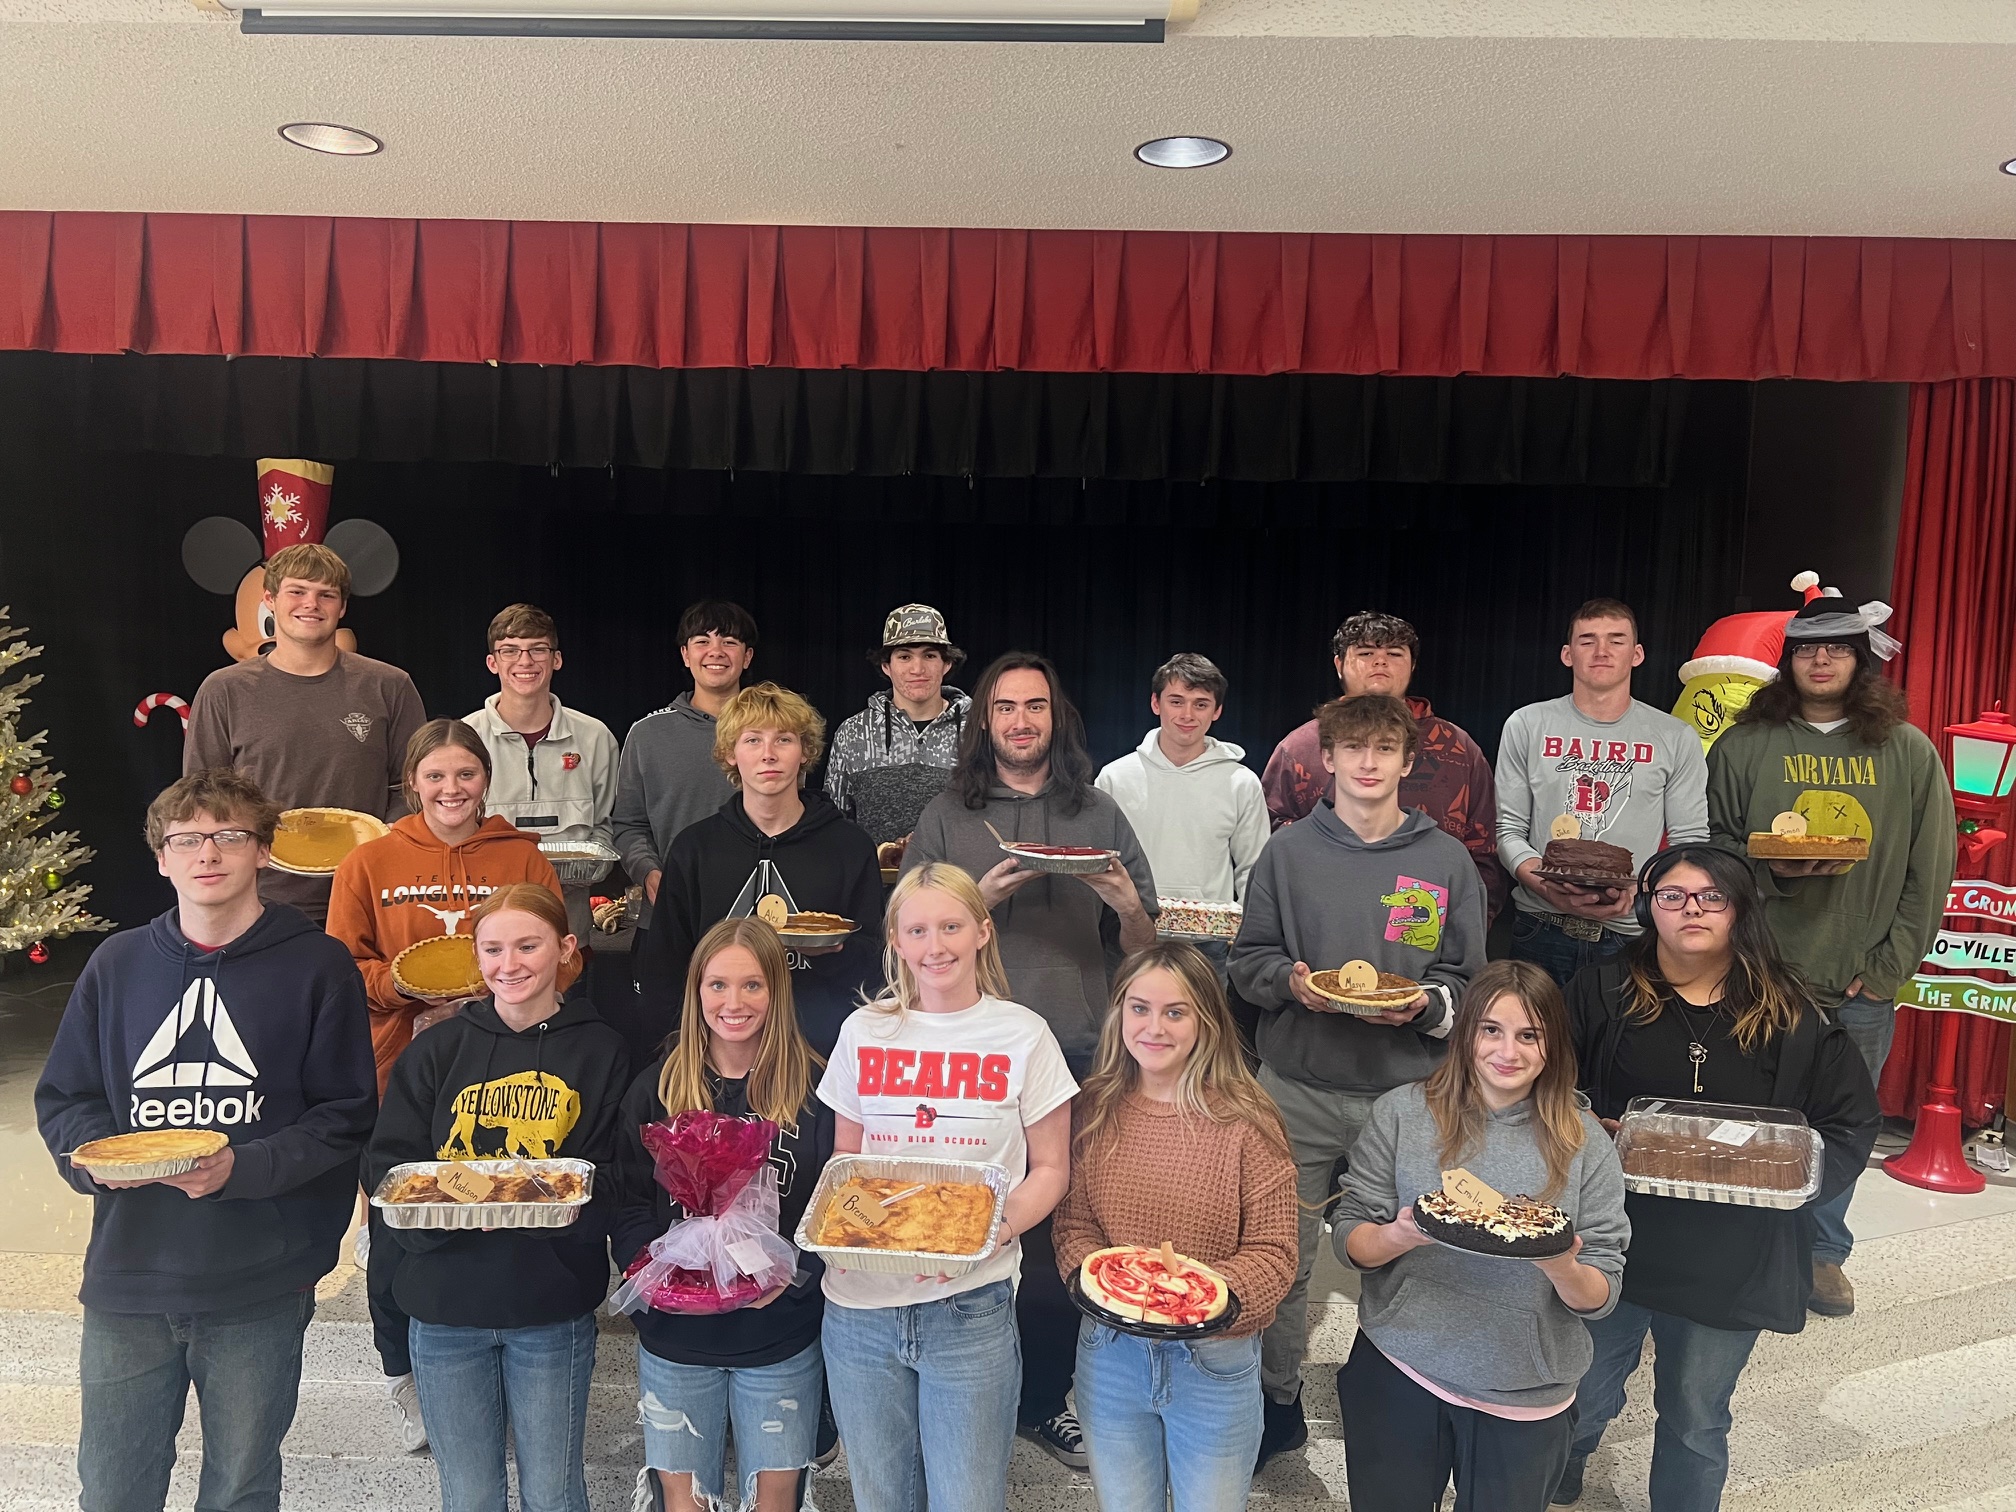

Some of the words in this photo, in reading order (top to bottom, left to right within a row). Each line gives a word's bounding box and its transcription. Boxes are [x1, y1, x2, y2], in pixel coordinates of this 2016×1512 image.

[1541, 735, 1655, 764] BAIRD
[1555, 754, 1635, 775] Basketball
[1782, 753, 1877, 785] NIRVANA
[381, 884, 499, 907] LONGHOR
[764, 909, 779, 924] Alex
[1928, 939, 2016, 963] O-VILLE
[1915, 983, 1952, 1007] THE
[857, 1046, 1011, 1102] BEARS
[130, 1090, 265, 1127] Reebok
[460, 1084, 560, 1120] YELLOWSTONE
[945, 1137, 987, 1145] SCHOOL
[448, 1172, 478, 1200] Madison
[842, 1194, 874, 1228] Brennan
